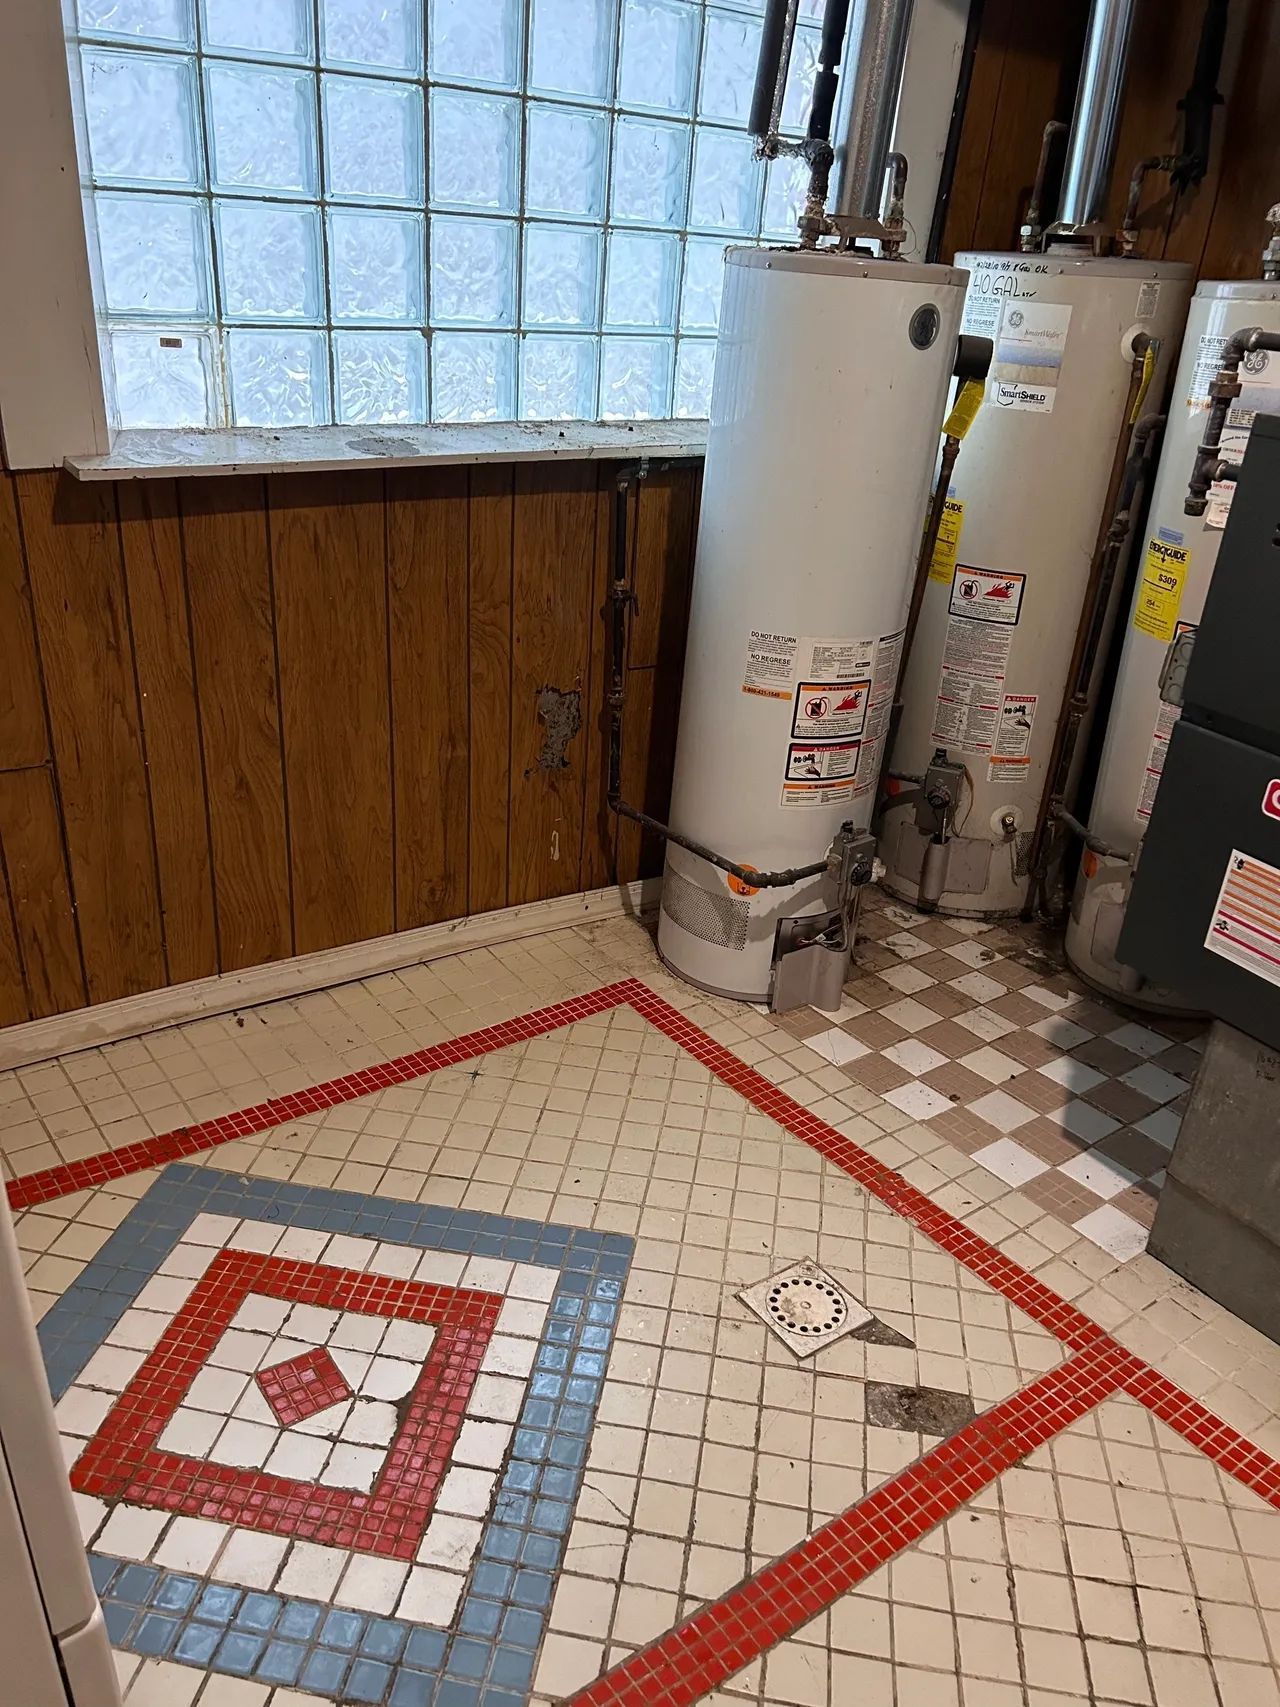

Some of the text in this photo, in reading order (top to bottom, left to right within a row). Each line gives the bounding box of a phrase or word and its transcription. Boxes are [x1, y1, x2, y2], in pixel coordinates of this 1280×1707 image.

[1035, 265, 1049, 274] OK
[974, 274, 1020, 297] 40 GAL
[1158, 573, 1178, 588] $309
[772, 635, 797, 643] RETURN
[760, 655, 791, 665] REGRESE
